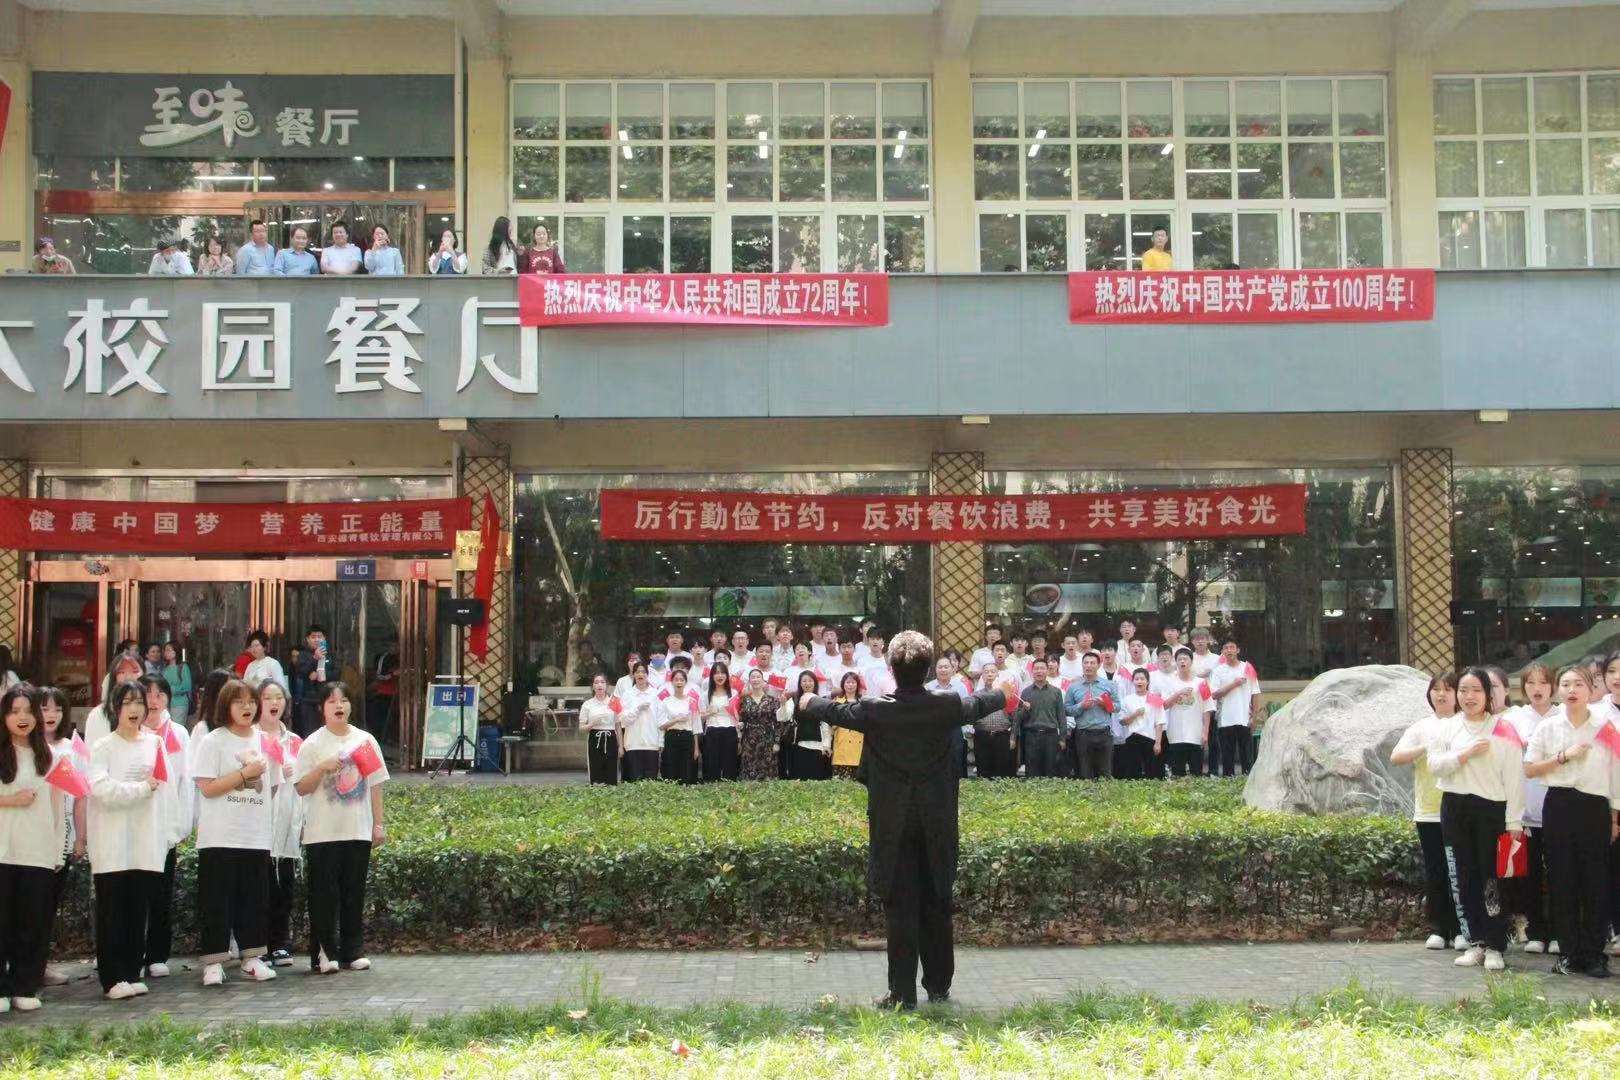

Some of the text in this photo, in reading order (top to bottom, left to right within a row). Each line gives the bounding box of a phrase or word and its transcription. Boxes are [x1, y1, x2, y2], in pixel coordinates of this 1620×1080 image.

[139, 80, 360, 148] 至味餐厅
[544, 279, 868, 316] 热烈庆祝中华人民共和国成立72周年！
[1095, 274, 1415, 314] 热烈庆祝中国共产党成立100周年！
[28, 509, 443, 535] 健康中国梦 营养正能量
[344, 564, 369, 575] 出口
[442, 691, 466, 701] 出口
